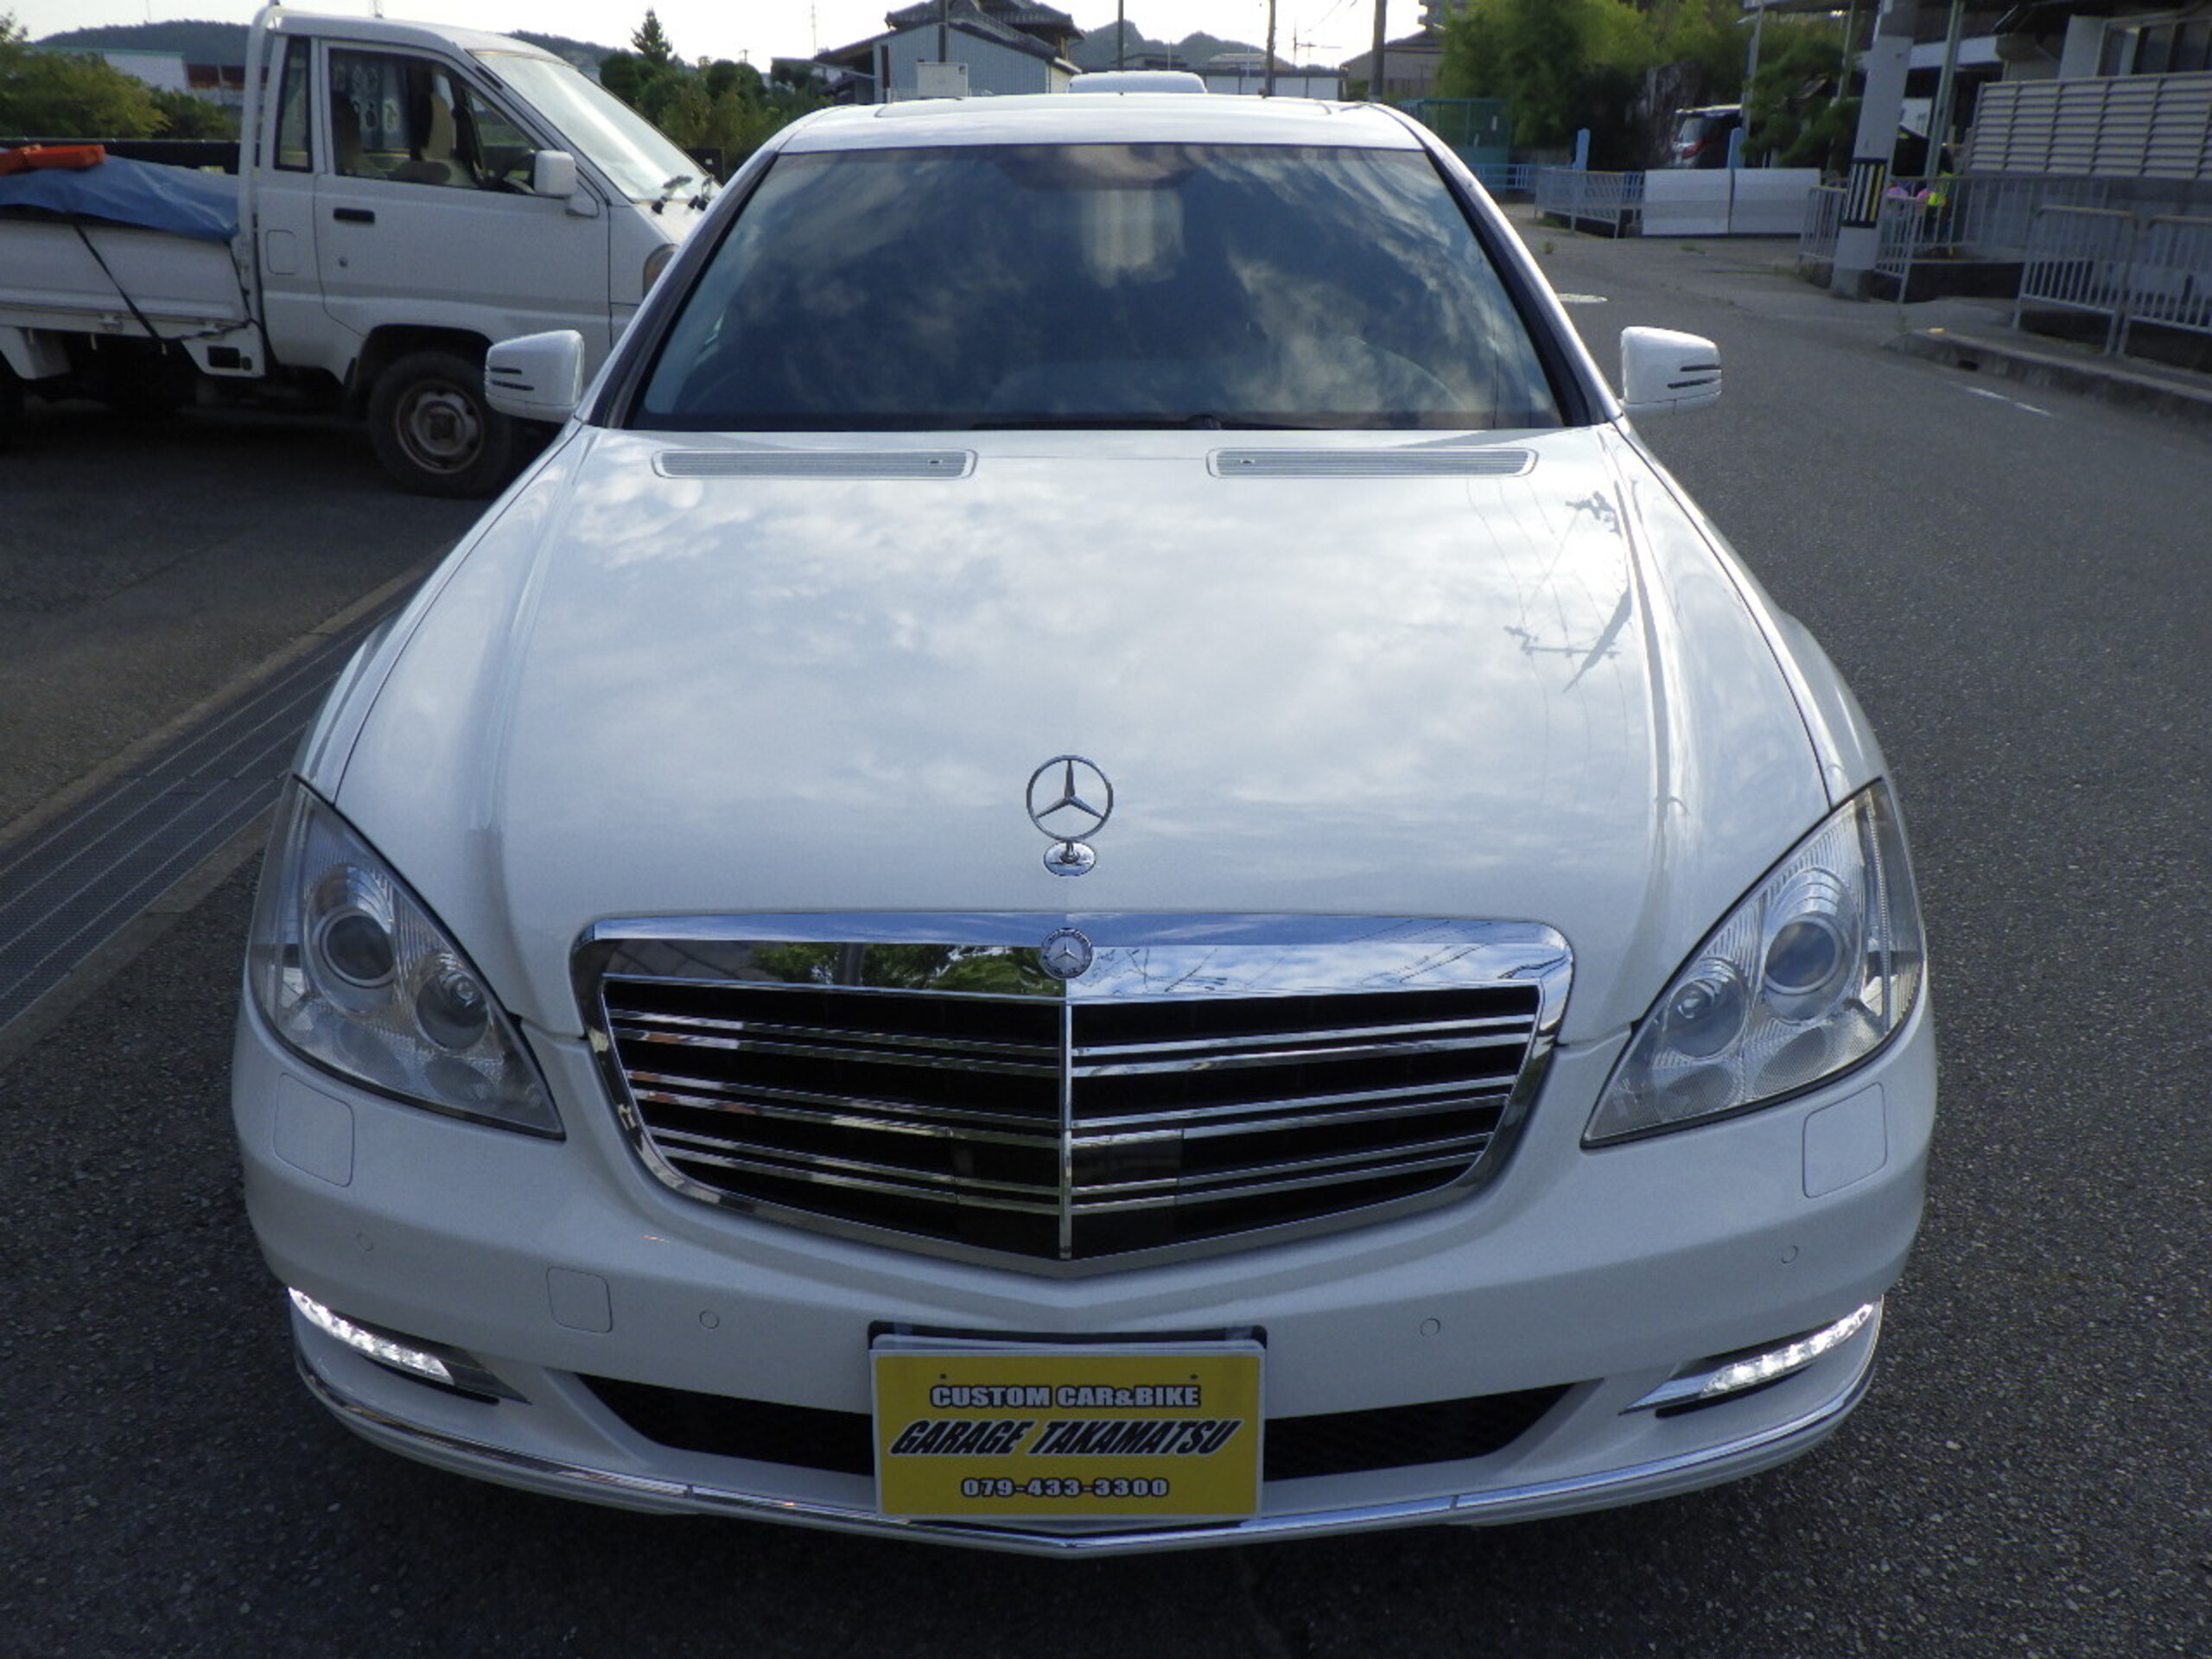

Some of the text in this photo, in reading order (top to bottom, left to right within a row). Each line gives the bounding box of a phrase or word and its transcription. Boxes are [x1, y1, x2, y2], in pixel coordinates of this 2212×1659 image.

[931, 1386, 1201, 1408] CUSTOM CAR&BIKE
[889, 1419, 1244, 1456] GARAGE TAKAMATSU
[961, 1478, 1169, 1497] 079-433-3300
